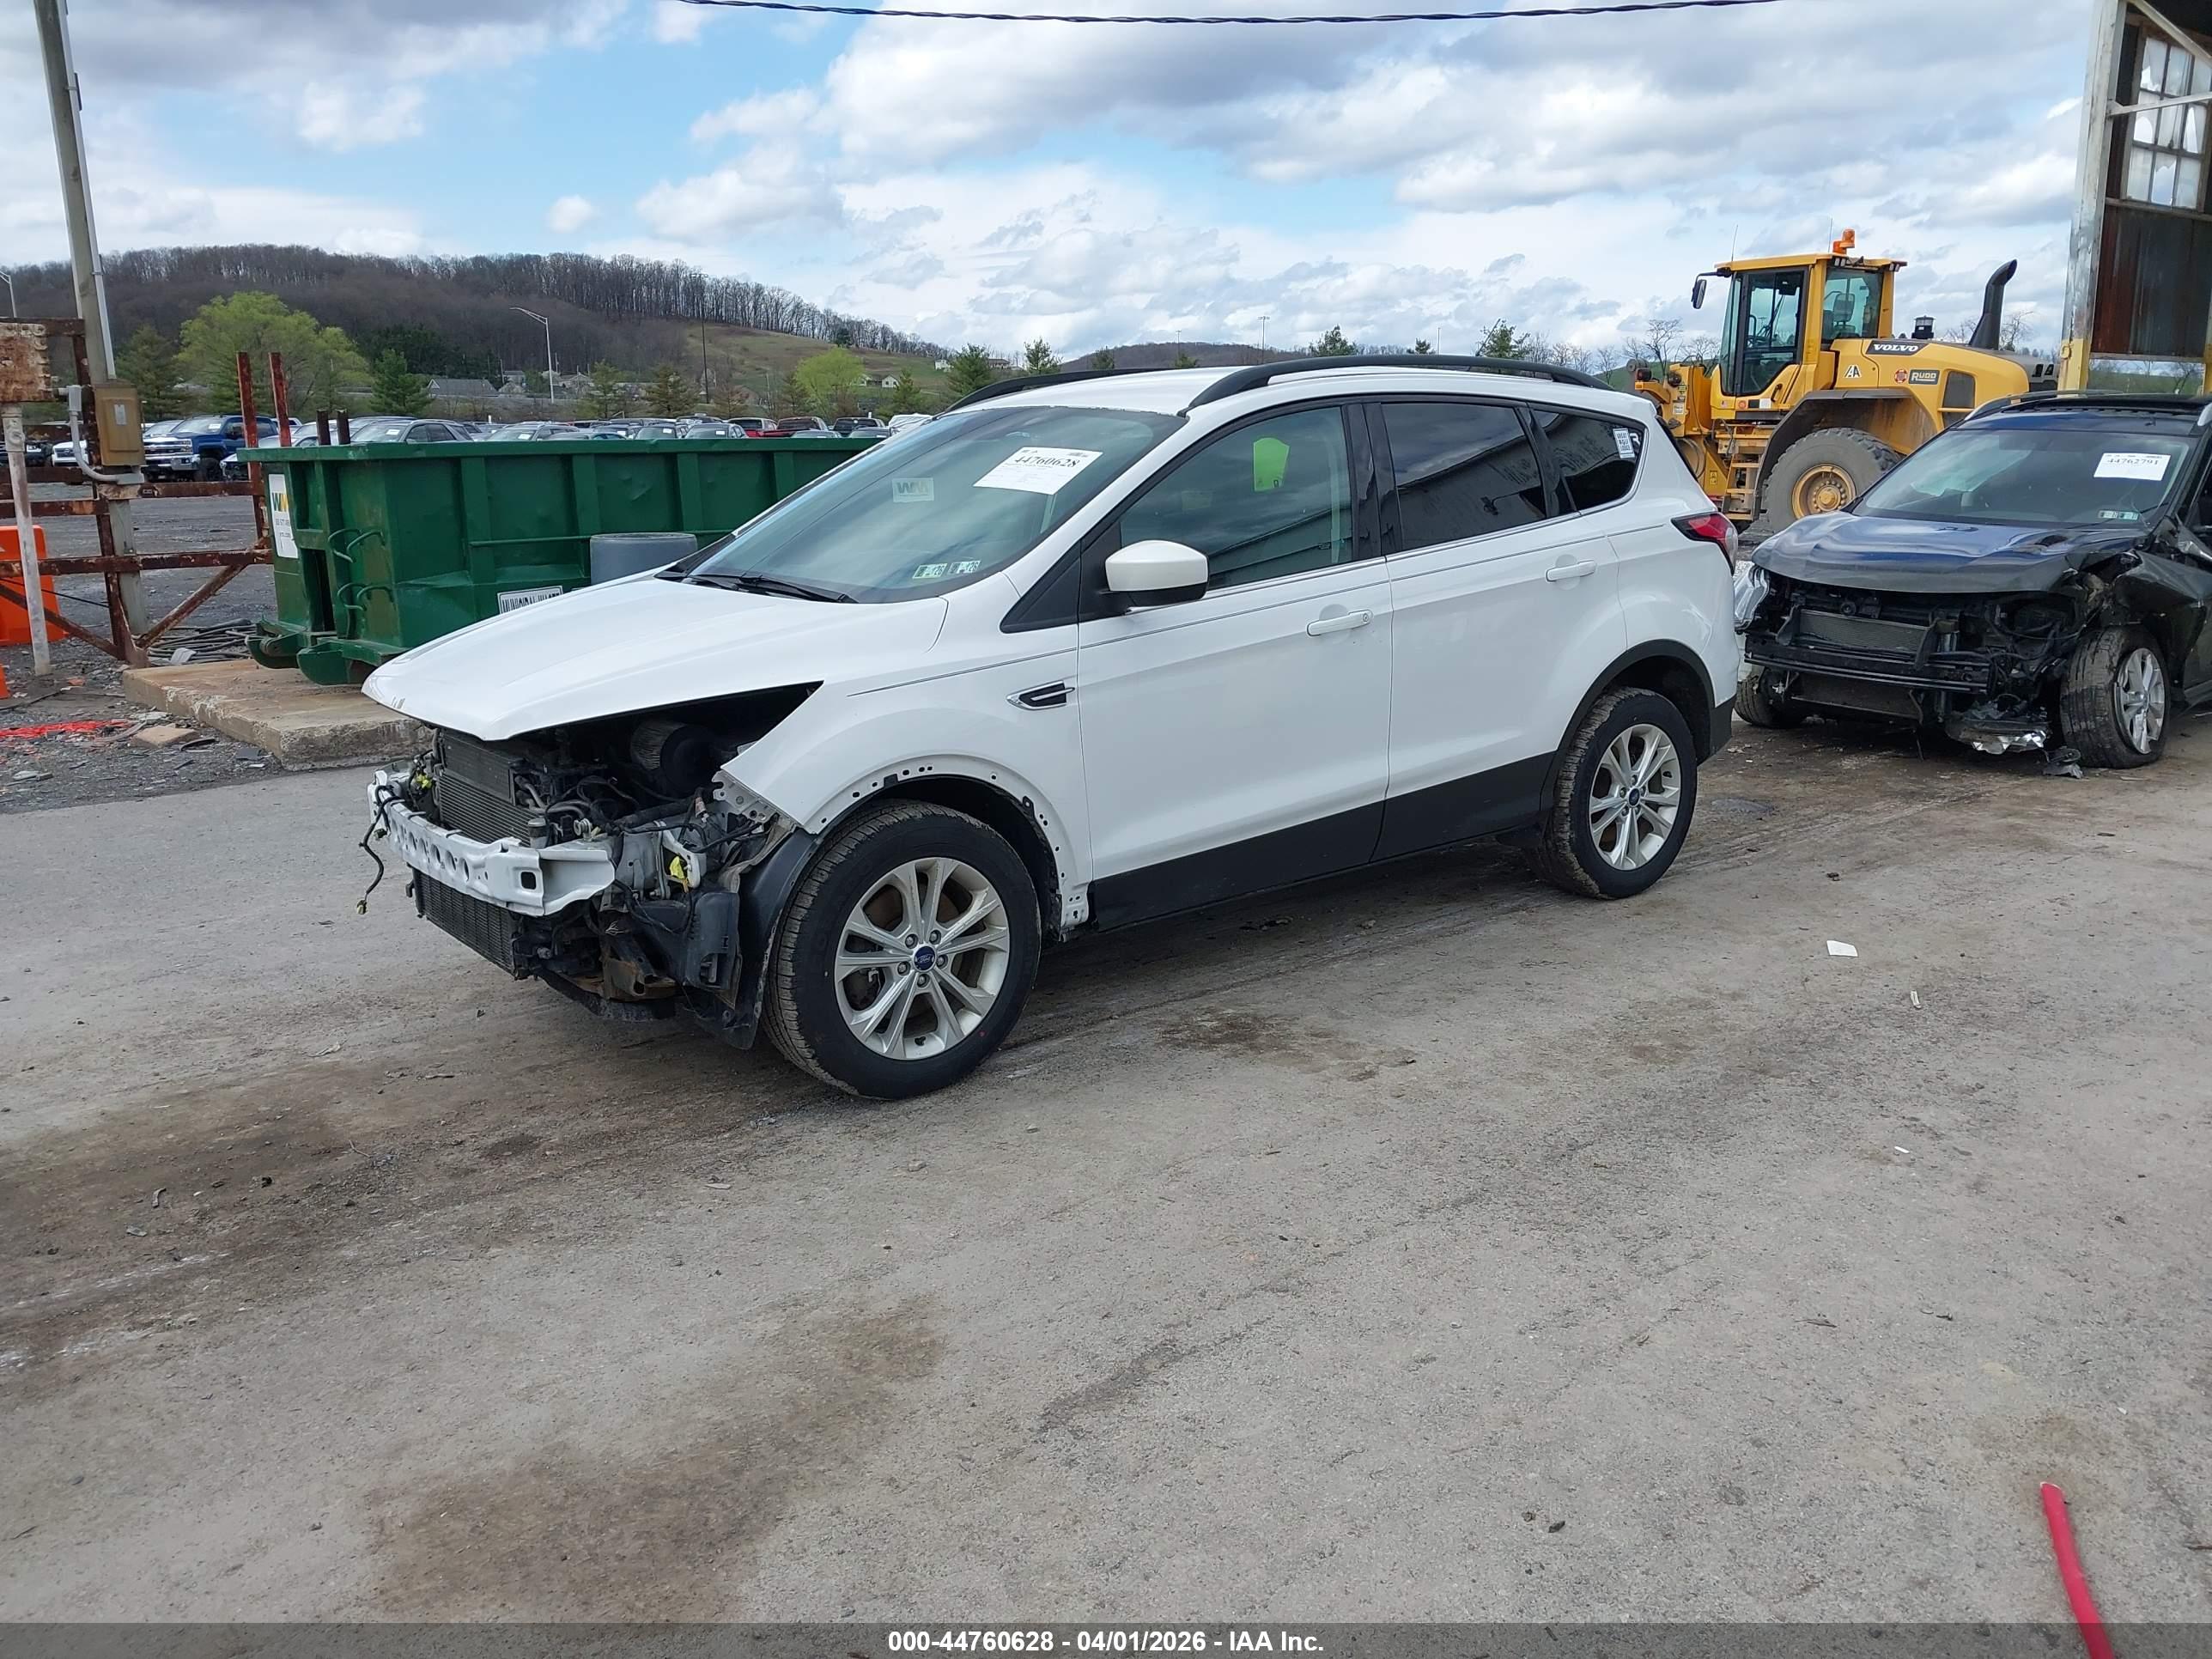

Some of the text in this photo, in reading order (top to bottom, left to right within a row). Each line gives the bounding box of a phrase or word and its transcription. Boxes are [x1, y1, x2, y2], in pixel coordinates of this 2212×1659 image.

[1873, 343, 1918, 352] VOLVO
[1911, 372, 1937, 381] RUDD
[1014, 455, 1081, 468] 44760628
